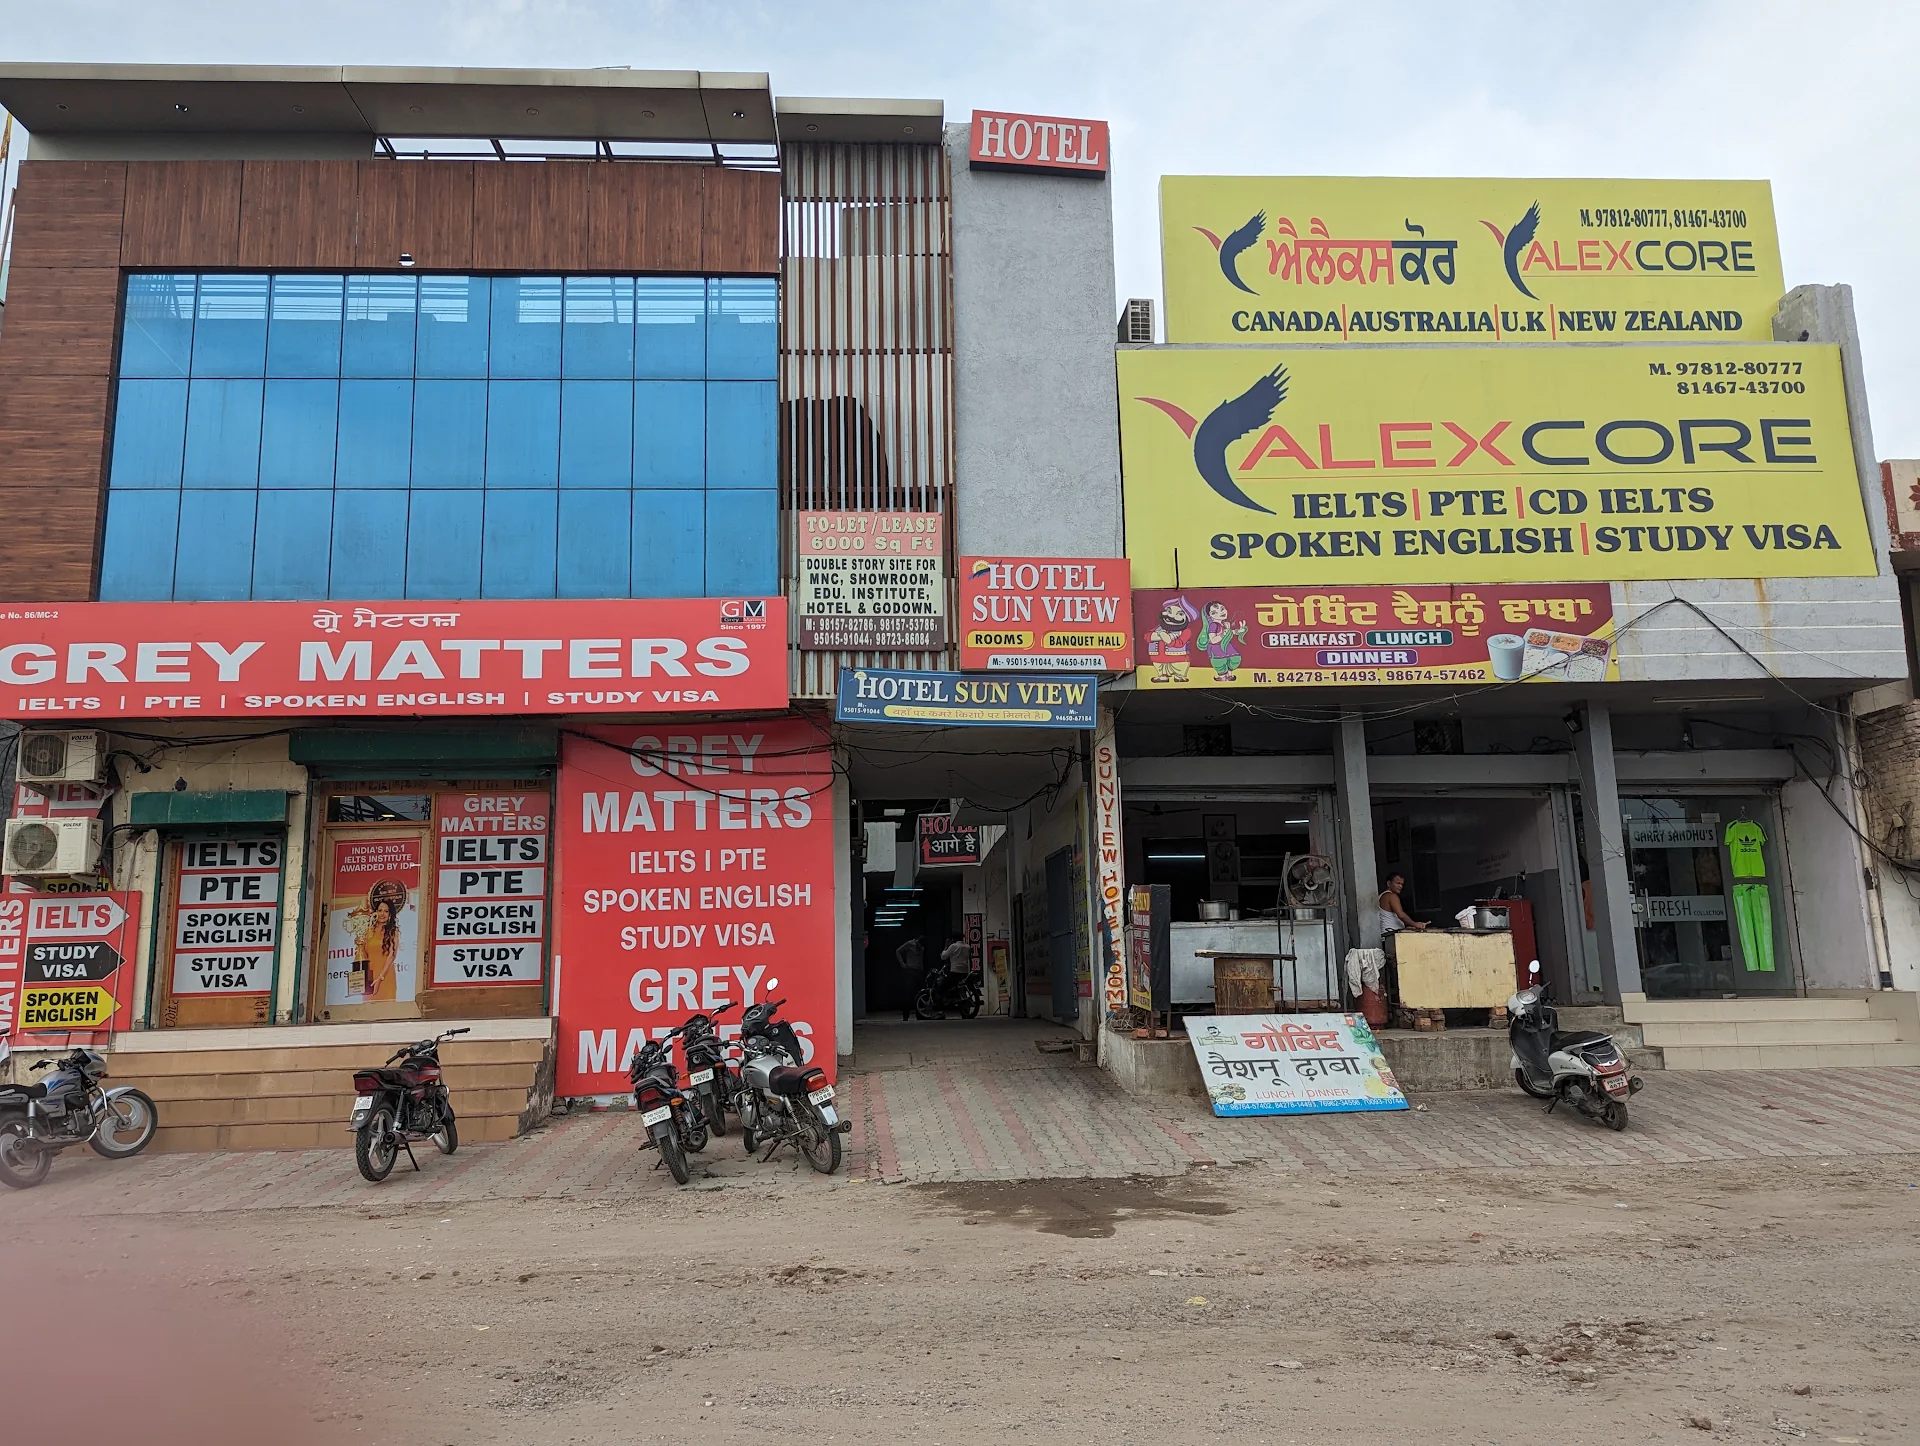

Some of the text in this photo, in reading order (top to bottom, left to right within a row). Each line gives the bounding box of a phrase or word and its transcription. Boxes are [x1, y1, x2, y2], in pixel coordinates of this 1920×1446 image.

[979, 117, 1099, 165] HOTEL
[1580, 209, 1747, 230] M. 97812-80777, 81467-43700
[1522, 240, 1756, 272] ALEXCORE
[1231, 310, 1743, 332] CANADA AUSTRALIA U.K NEW ZEALAND
[1649, 362, 1803, 376] M. 97812-80777
[1677, 381, 1805, 395] 81467-43700
[1238, 418, 1818, 471] ALEXCORE
[1292, 487, 1715, 519] IELTS PTE CD IELTS
[811, 536, 933, 552] 6000 Sq Ft
[1209, 524, 1842, 559] SPOKEN ENGLISH STUDY VISA
[806, 558, 936, 571] DOUBLE STORY SITE FOR
[810, 573, 934, 586] MNC, SHOWROOM,
[987, 564, 1105, 591] HOTEL
[814, 588, 930, 600] EDU. INSTITUTE,
[24, 611, 59, 619] 86/MC-2
[806, 602, 937, 615] HOTEL & GODOWN.
[972, 595, 1120, 623] SUN VIEW
[1498, 598, 1594, 623] ਢਾਬਾ
[805, 618, 815, 631] M:
[975, 634, 1023, 645] ROOMS
[1049, 635, 1120, 647] BANQUET HALL
[1269, 632, 1356, 646] BREAKFAST
[1375, 632, 1442, 645] LUNCH
[0, 637, 751, 685] GREY MATTERS
[1006, 657, 1054, 667] 95015-91044,
[1056, 658, 1101, 666] 94650-67184
[1327, 651, 1409, 664] DINNER
[1253, 669, 1486, 684] M. 84278-14493, 98674-57462
[856, 677, 1088, 705] HOTEL SUN VIEW
[18, 690, 720, 711] IELTS PTE SPOKEN ENGLISH STUDY VISA
[843, 707, 880, 715] 95015-91044
[928, 709, 952, 718] कमरे
[1003, 710, 1031, 719] मिलते
[630, 734, 765, 777] GREY
[464, 796, 526, 812] GREY
[582, 787, 812, 833] MATTERS
[441, 815, 547, 833] MATTERS
[932, 833, 976, 853] आगे है
[1667, 829, 1714, 842] SANDHU'S
[188, 841, 277, 866] IELTS
[352, 844, 405, 854] INDIA'S NO.1
[445, 837, 540, 862] IELTS
[344, 854, 412, 864] IELTS INSTITUTE
[630, 848, 766, 874] IELTS PTE
[340, 863, 385, 873] AWARDED
[200, 876, 261, 900] PTE
[459, 871, 523, 895] PTE
[584, 883, 811, 913] SPOKEN ENGLISH
[446, 905, 534, 920] SPOKEN
[1651, 900, 1692, 917] FRESH
[36, 905, 111, 929] IELTS
[187, 912, 270, 927] SPOKEN
[182, 928, 272, 944] ENGLISH
[443, 921, 536, 936] ENGLISH
[620, 922, 775, 950] STUDY VISA
[33, 945, 100, 961] STUDY
[452, 947, 525, 962] STUDY
[42, 964, 88, 978] VISA
[191, 956, 260, 972] STUDY
[462, 964, 513, 978] VISA
[200, 974, 248, 988] VISA
[629, 965, 767, 1013] GREY
[26, 991, 99, 1006] SPOKEN
[25, 1008, 97, 1023] ENGLISH
[1240, 1023, 1344, 1052] गोबिंद
[1207, 1052, 1290, 1087] वैशनू
[1256, 1088, 1351, 1100] LUNCH DINNER
